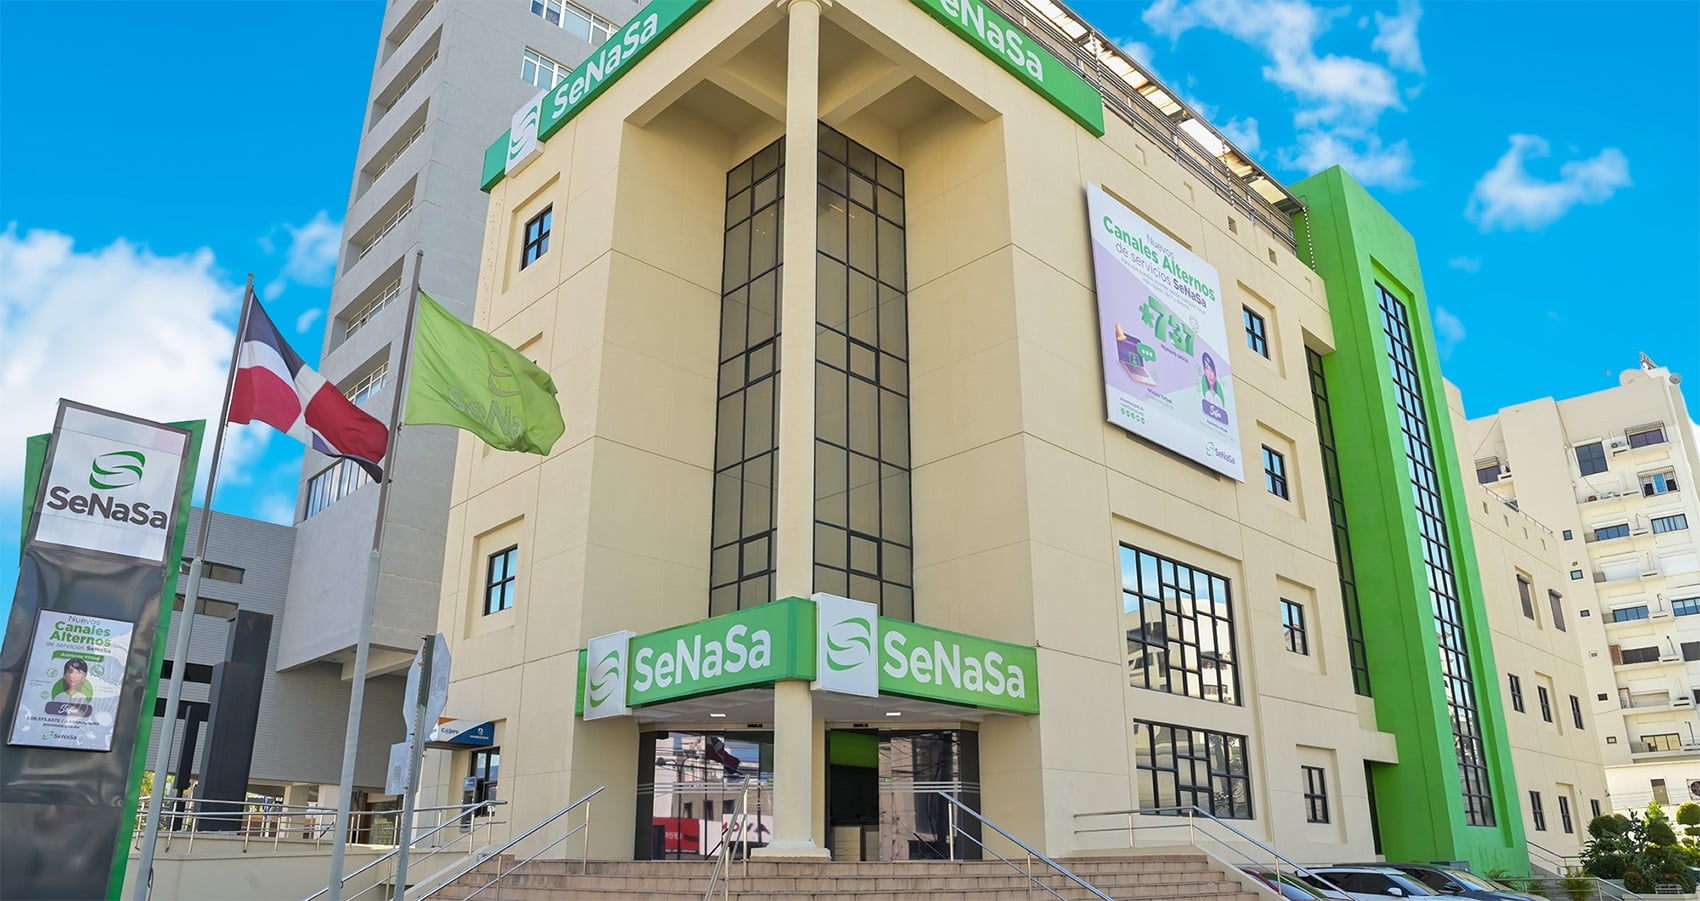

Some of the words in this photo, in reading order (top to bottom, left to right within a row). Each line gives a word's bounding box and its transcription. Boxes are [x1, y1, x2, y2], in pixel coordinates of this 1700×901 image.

[940, 0, 1043, 82] eNaSa
[552, 13, 658, 119] SeNaSa
[1103, 215, 1159, 264] Canales
[1162, 255, 1216, 302] Alternos
[1146, 233, 1175, 260] Nuevos
[1115, 243, 1129, 258] de
[1130, 252, 1171, 286] servicios
[1173, 278, 1207, 308] SeNaSa
[448, 386, 523, 440] SeNa
[1214, 448, 1236, 465] SeNaSa
[47, 486, 168, 530] SeNaSa
[49, 630, 112, 647] Alternos
[55, 621, 111, 637] Canales
[68, 615, 101, 626] Nuevos
[56, 641, 85, 650] servicios
[86, 645, 111, 653] SeNaSa
[633, 624, 772, 693] SeNaSa
[883, 630, 1025, 698] SeNaSa
